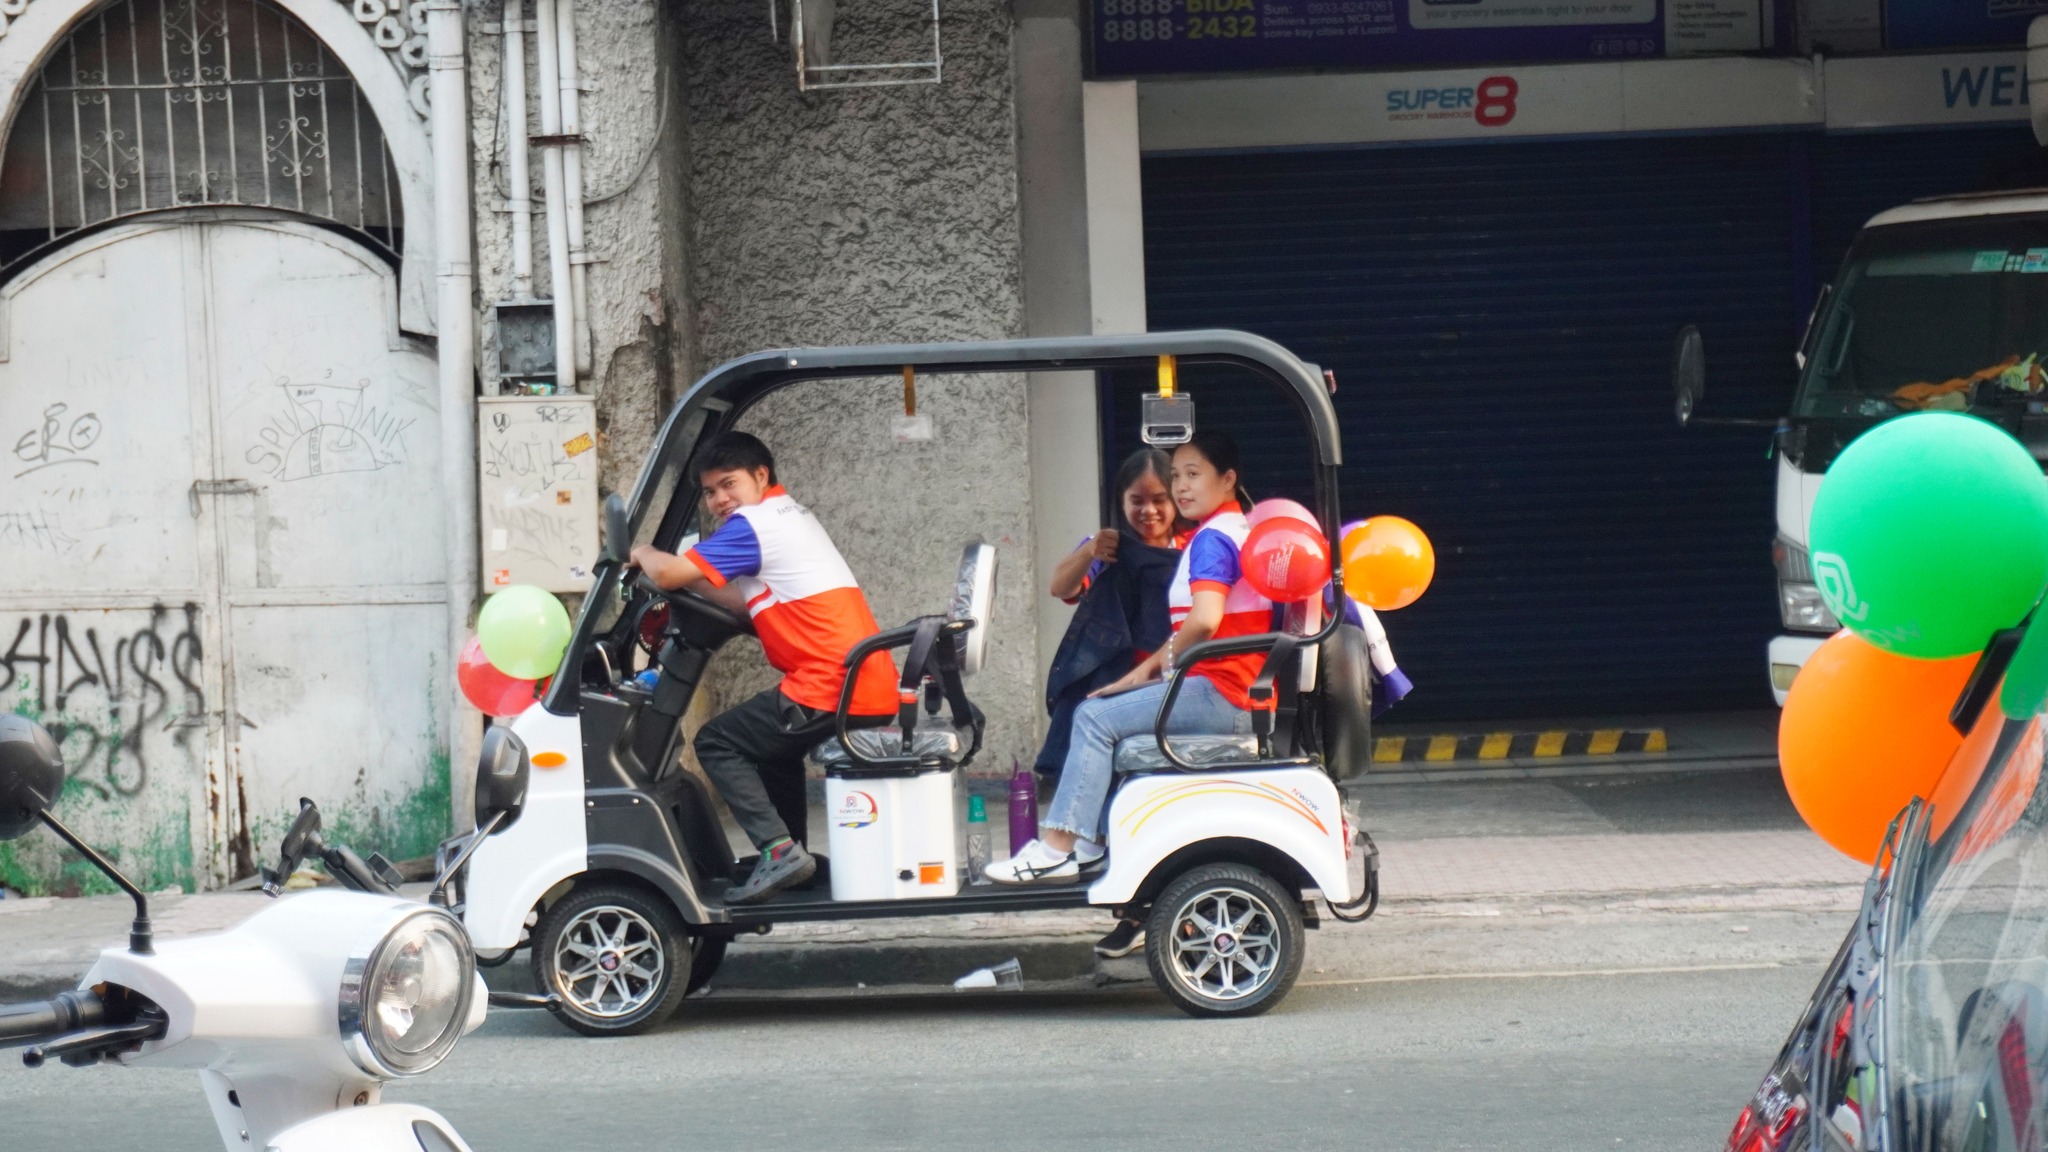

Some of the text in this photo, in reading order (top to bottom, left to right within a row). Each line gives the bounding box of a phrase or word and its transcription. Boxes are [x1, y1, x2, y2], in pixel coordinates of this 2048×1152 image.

[1103, 15, 1256, 42] 8888-2432
[1386, 75, 1519, 127] SUPER 8
[1291, 788, 1320, 811] NWOW
